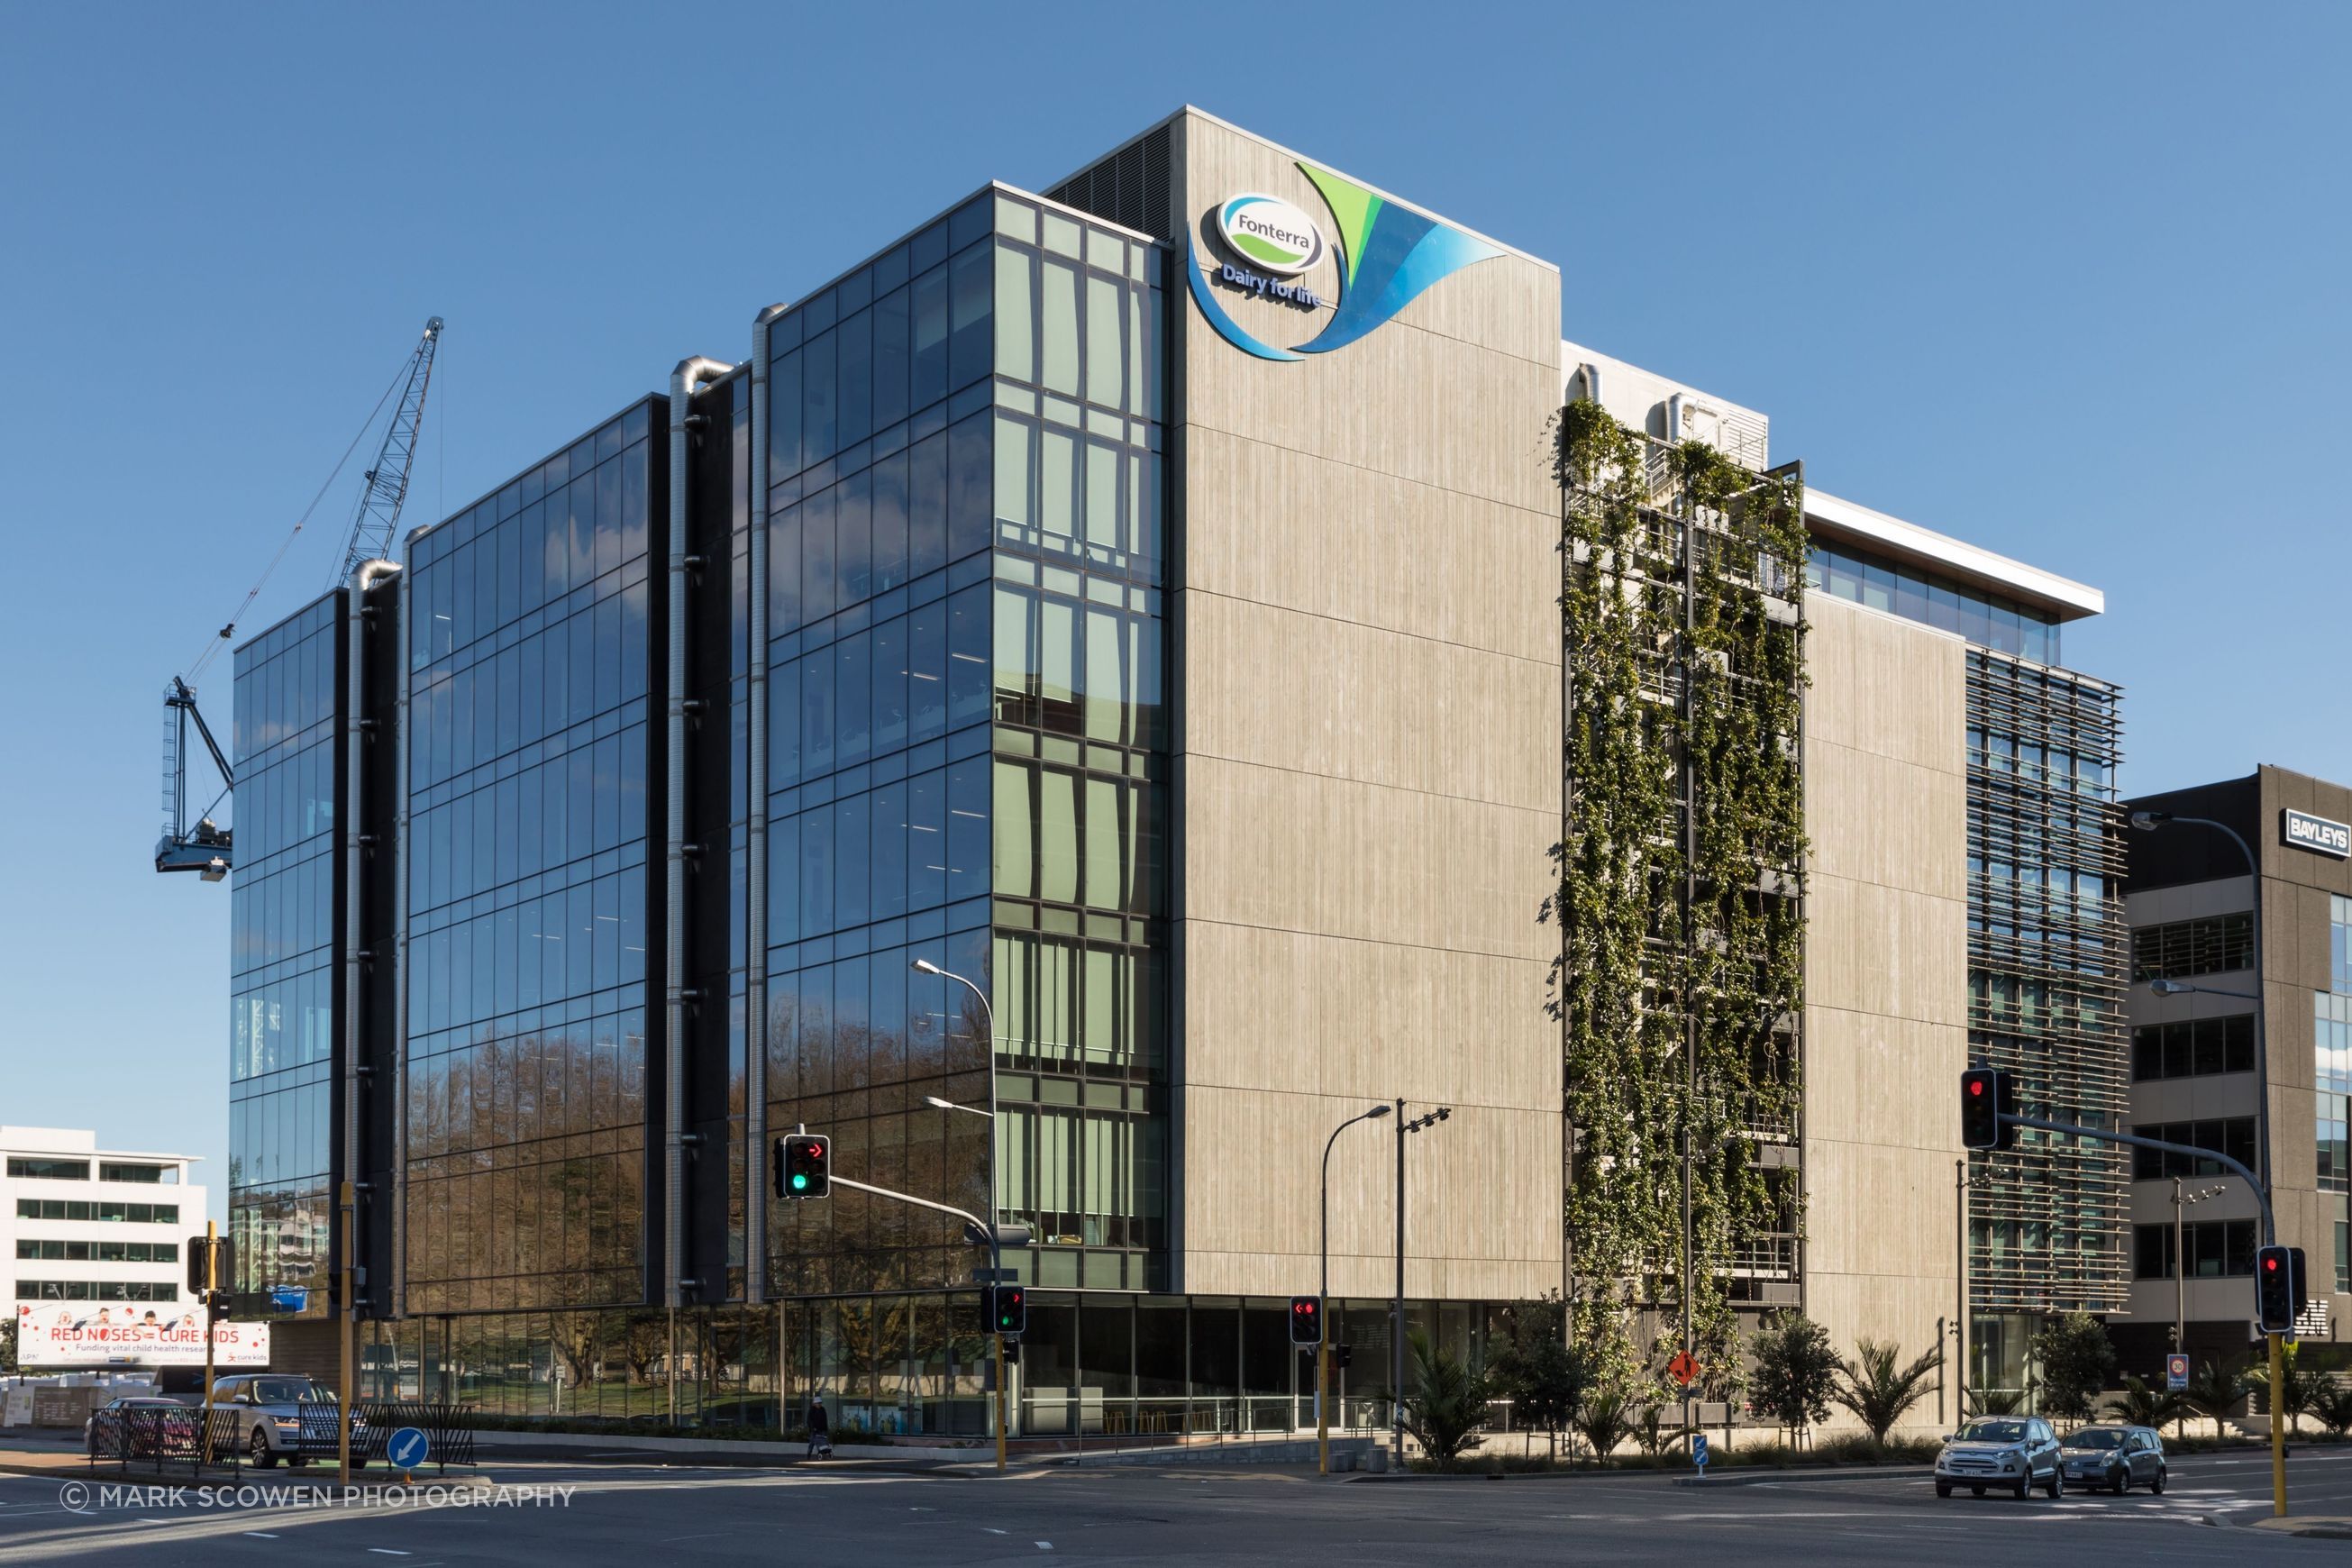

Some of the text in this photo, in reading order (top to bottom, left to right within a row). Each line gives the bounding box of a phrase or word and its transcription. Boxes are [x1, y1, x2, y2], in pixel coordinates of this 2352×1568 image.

[1238, 214, 1309, 249] Fonterra
[1222, 263, 1322, 307] Dairy for life
[2290, 817, 2347, 849] BAYLEYS
[51, 1327, 83, 1341] RED
[87, 1327, 141, 1342] NOSES
[160, 1329, 199, 1343] CURE
[76, 1344, 110, 1353] Funding
[113, 1344, 131, 1352] vital
[153, 1345, 179, 1353] health
[2174, 1363, 2183, 1371] 30
